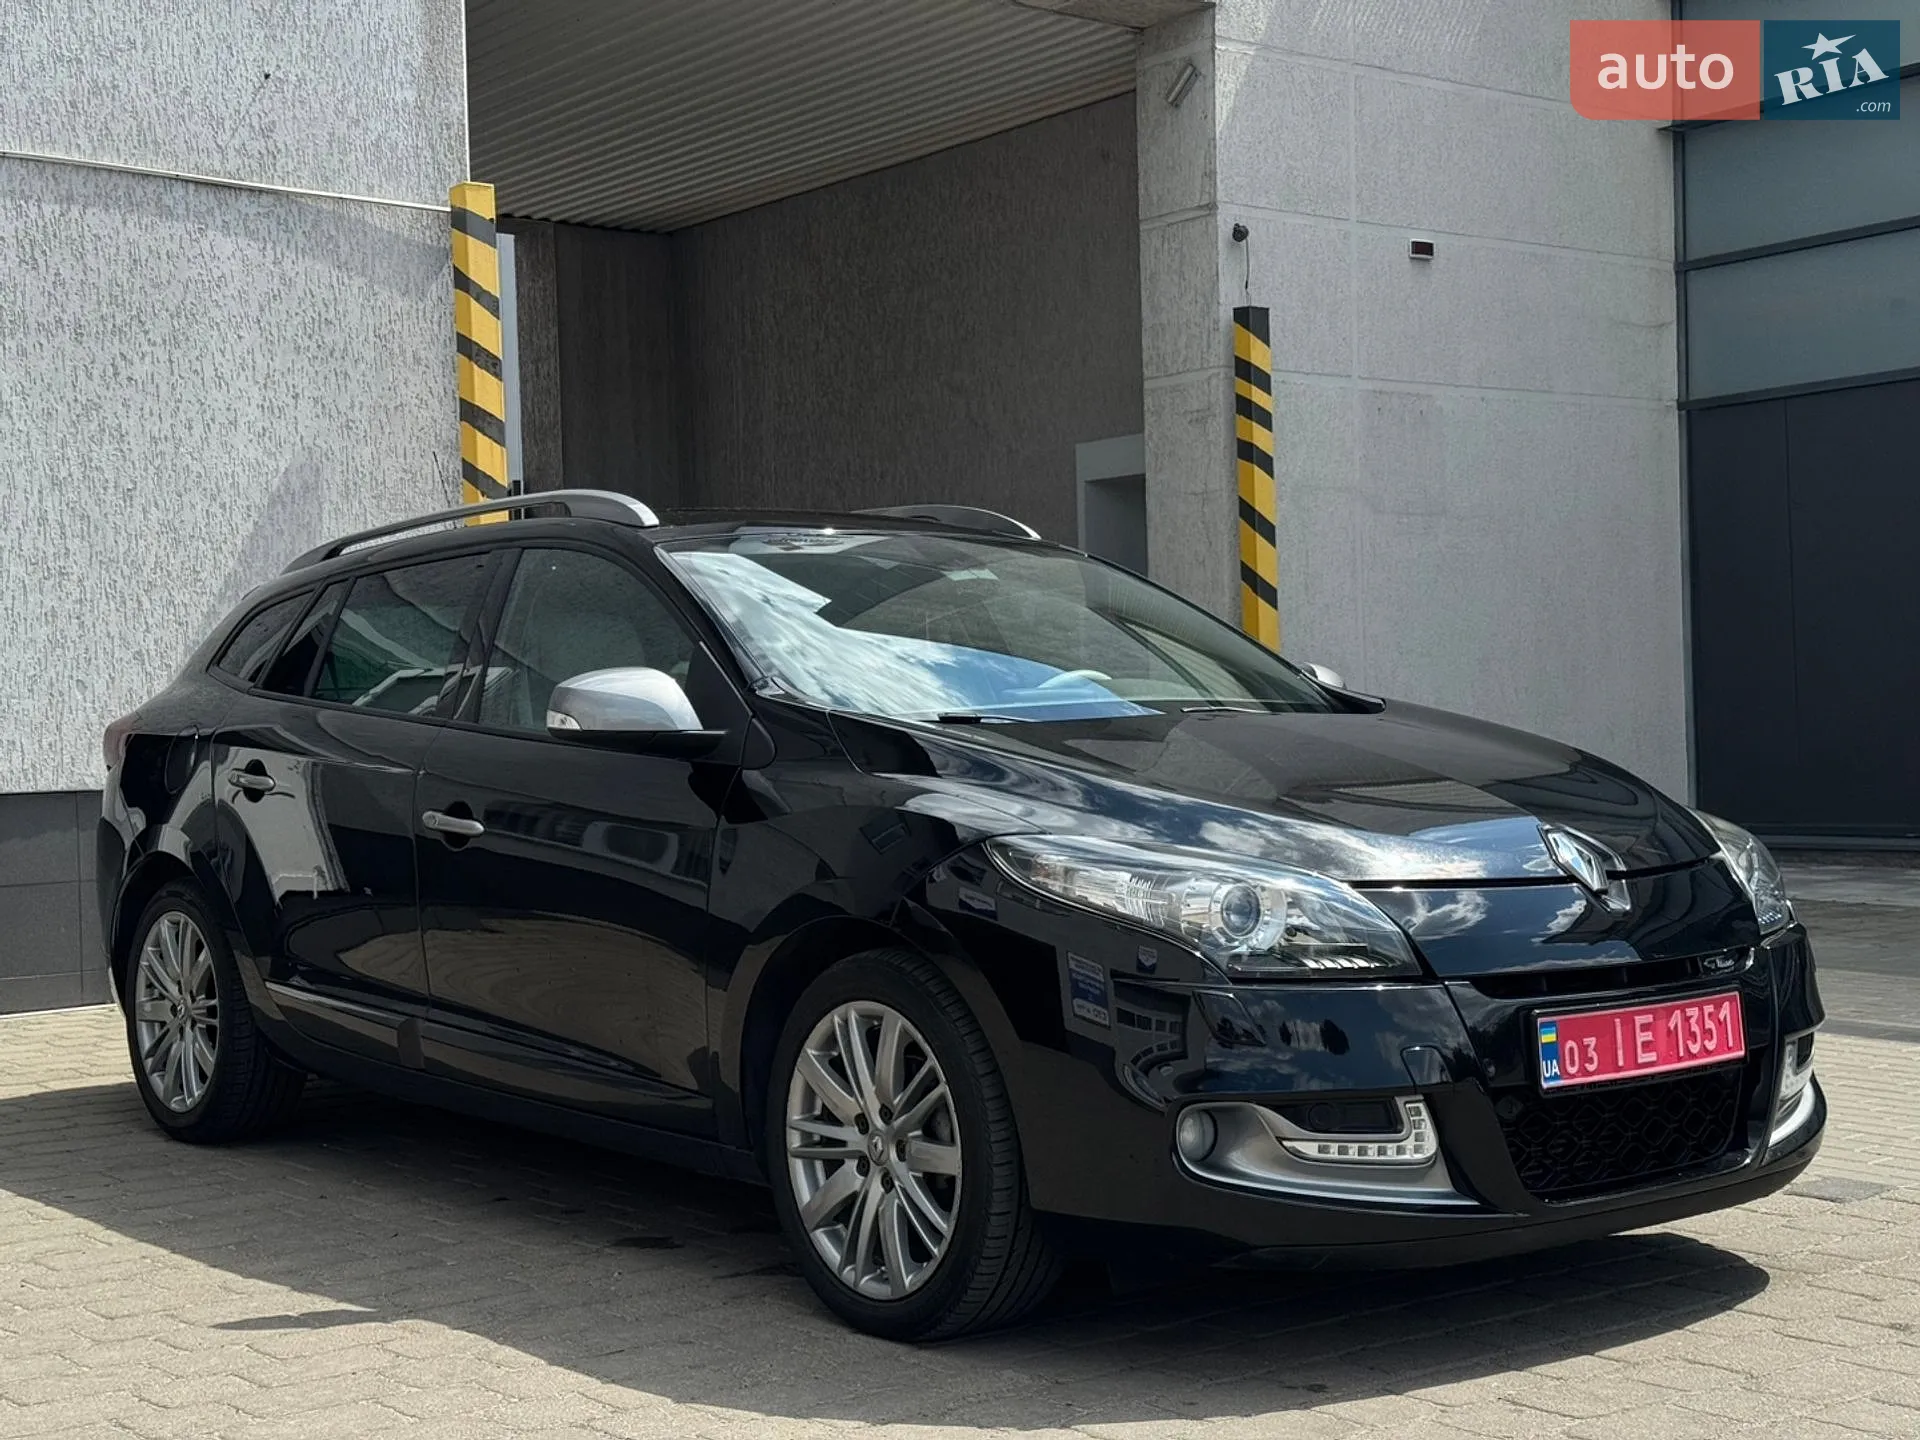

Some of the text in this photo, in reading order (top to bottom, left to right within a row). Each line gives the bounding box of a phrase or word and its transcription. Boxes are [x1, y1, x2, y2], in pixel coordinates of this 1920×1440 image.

[1564, 1037, 1598, 1074] 03
[1668, 1001, 1733, 1057] 1351
[1543, 1060, 1560, 1077] UA
